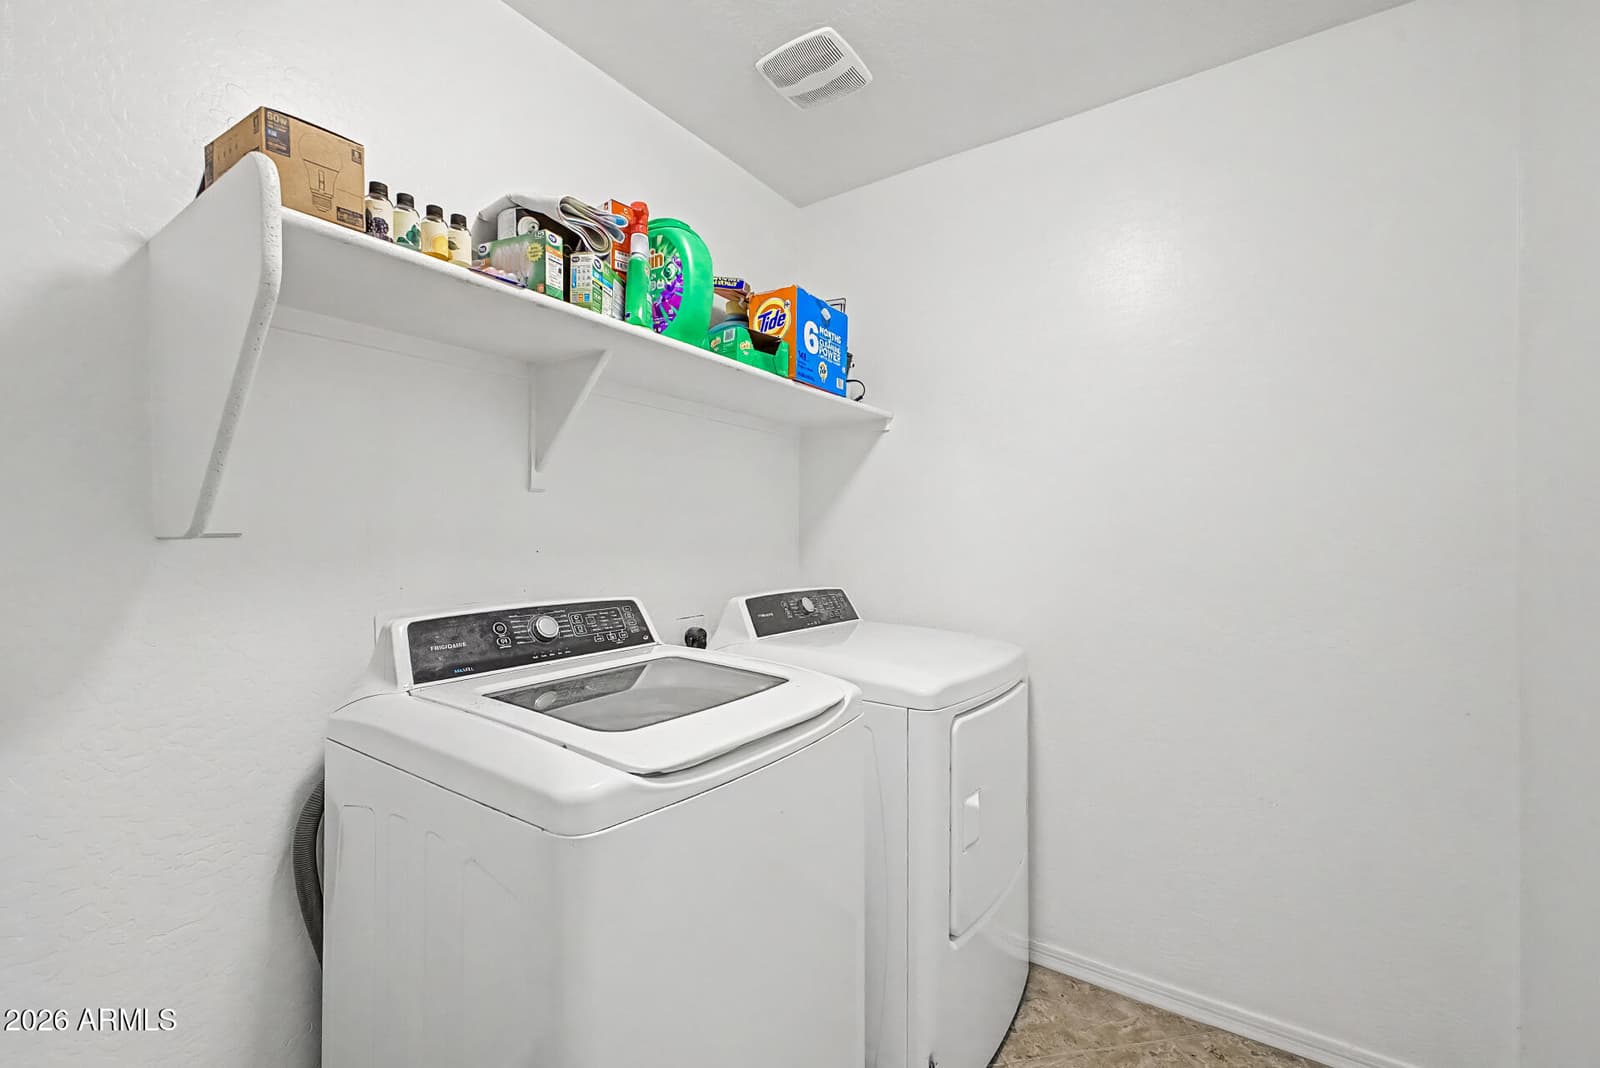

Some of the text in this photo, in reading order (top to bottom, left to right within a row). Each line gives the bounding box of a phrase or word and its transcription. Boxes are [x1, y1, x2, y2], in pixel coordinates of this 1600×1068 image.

[649, 249, 665, 271] in
[758, 309, 786, 332] Tide
[804, 320, 842, 355] 6 MONTHS
[819, 346, 841, 362] POWER
[430, 641, 467, 652] FRIGIDAIRE
